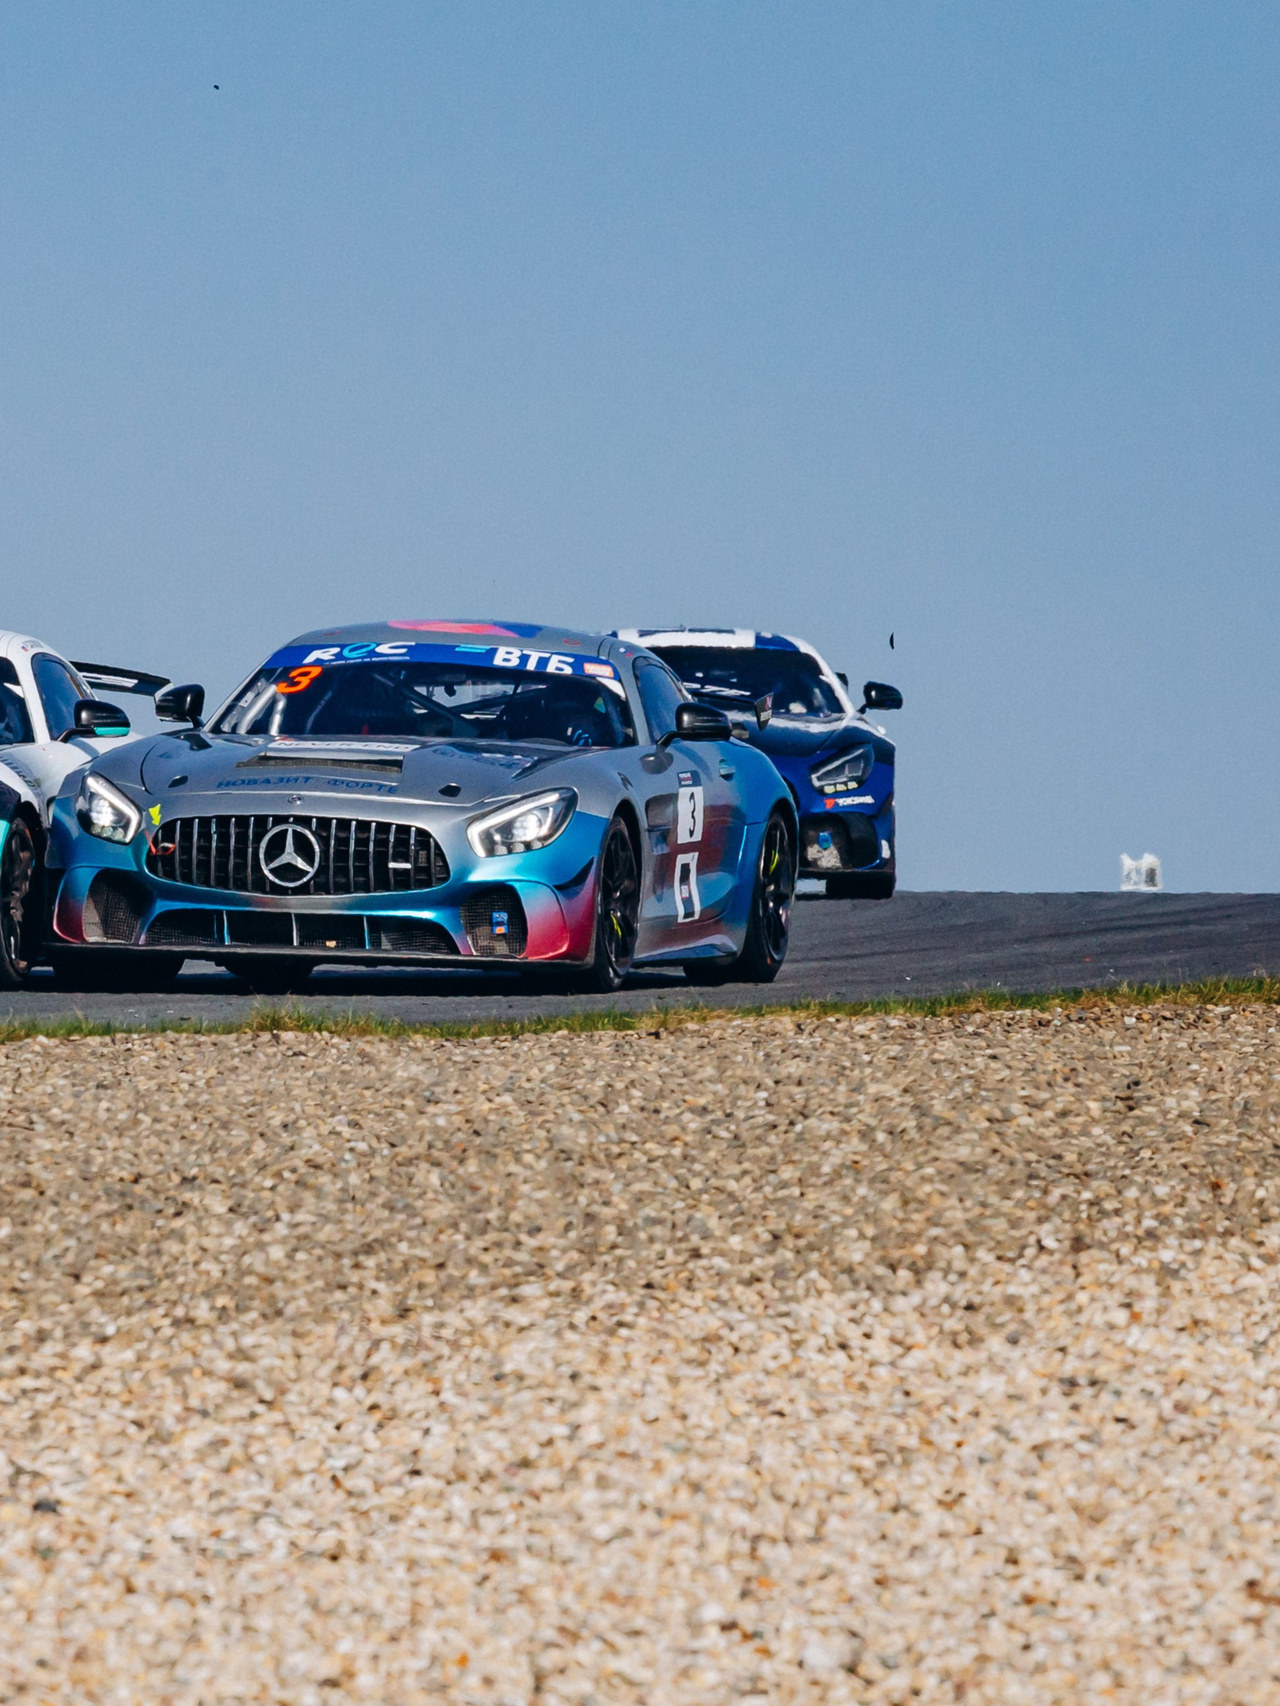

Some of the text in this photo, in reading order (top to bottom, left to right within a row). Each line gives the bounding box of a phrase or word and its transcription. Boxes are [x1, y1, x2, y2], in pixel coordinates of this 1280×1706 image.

[492, 646, 575, 675] ВТБ
[276, 665, 323, 693] 3
[327, 779, 398, 794] ФОРТЕ
[688, 791, 696, 838] 3
